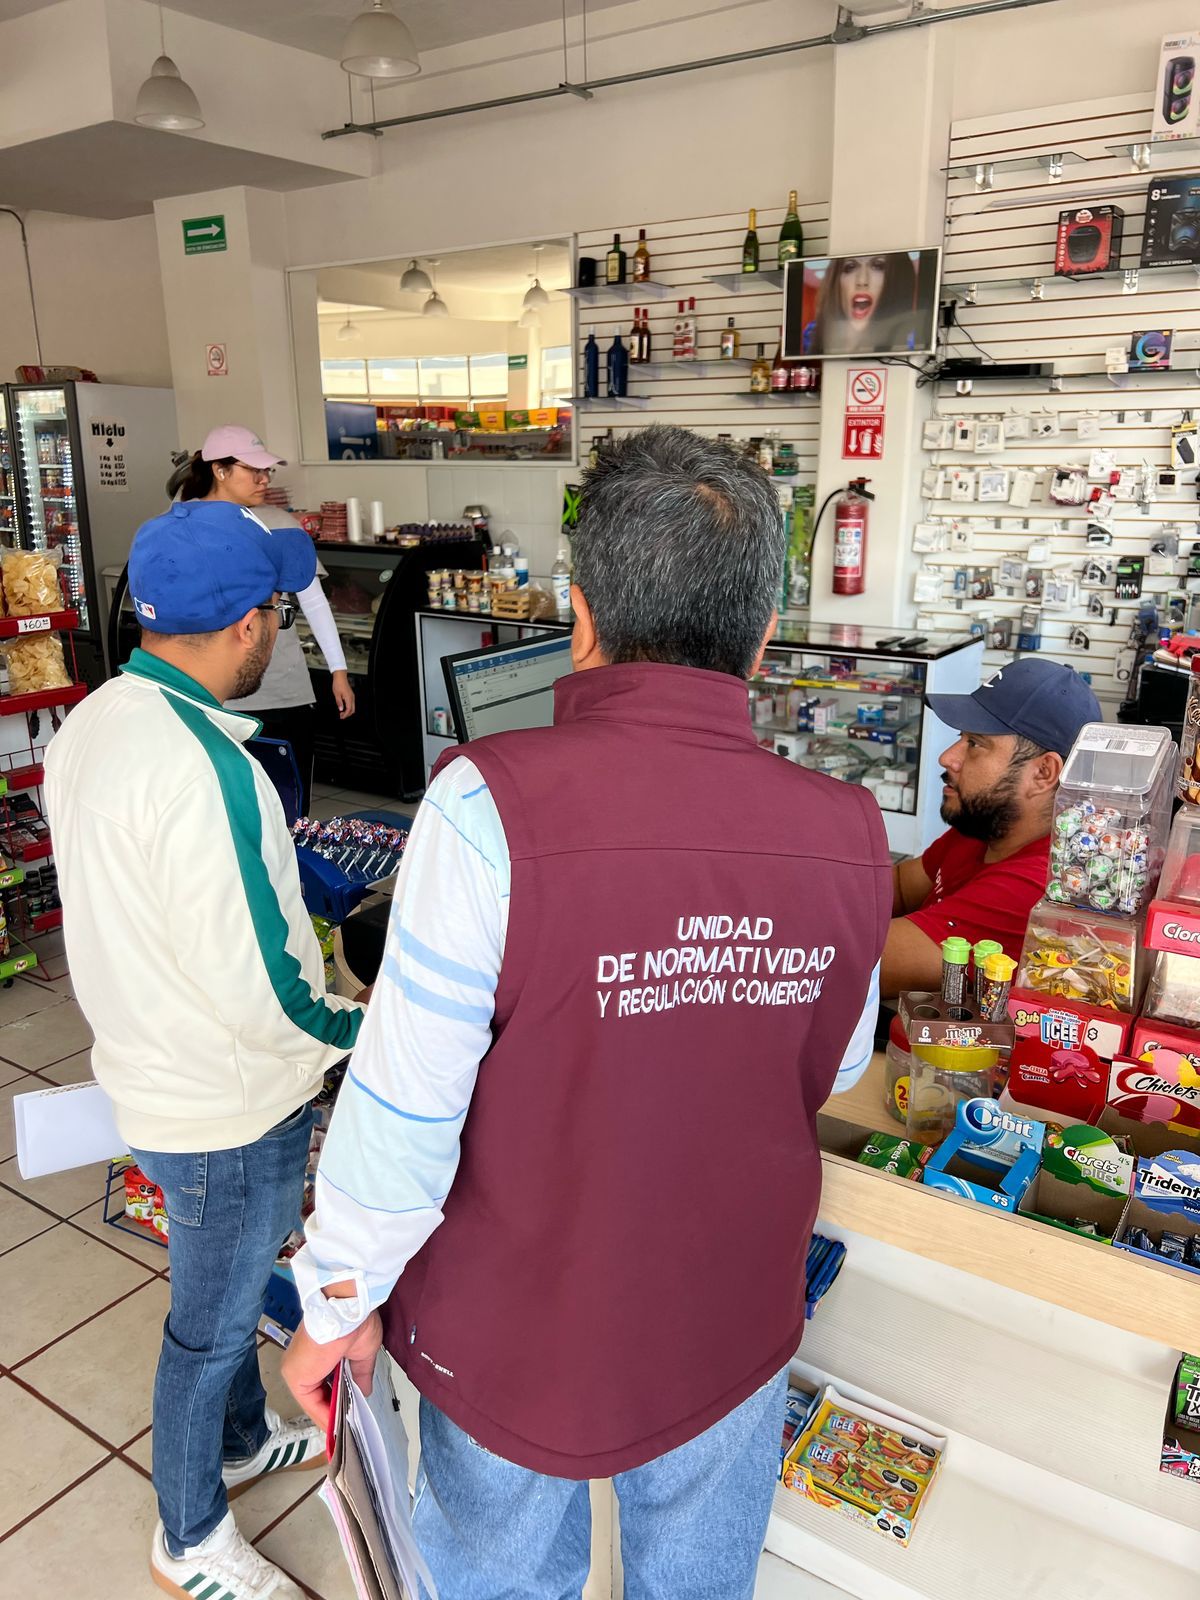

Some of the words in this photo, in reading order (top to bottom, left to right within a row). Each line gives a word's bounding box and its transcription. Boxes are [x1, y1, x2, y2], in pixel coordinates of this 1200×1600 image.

[1151, 189, 1161, 201] 8
[677, 915, 773, 941] UNIDAD
[1162, 923, 1200, 945] Clor
[597, 953, 638, 983] DE
[643, 946, 836, 980] NORMATIVIDAD
[597, 991, 612, 1018] Y
[618, 974, 728, 1018] REGULACIÓN
[731, 977, 825, 1006] COMERCIAL
[922, 1026, 930, 1038] 6
[1045, 1021, 1079, 1043] ICEE
[1135, 1077, 1198, 1100] Chiclets
[963, 1098, 1034, 1138] Orbit
[1063, 1146, 1119, 1174] Clorets
[1141, 1169, 1200, 1199] Trident
